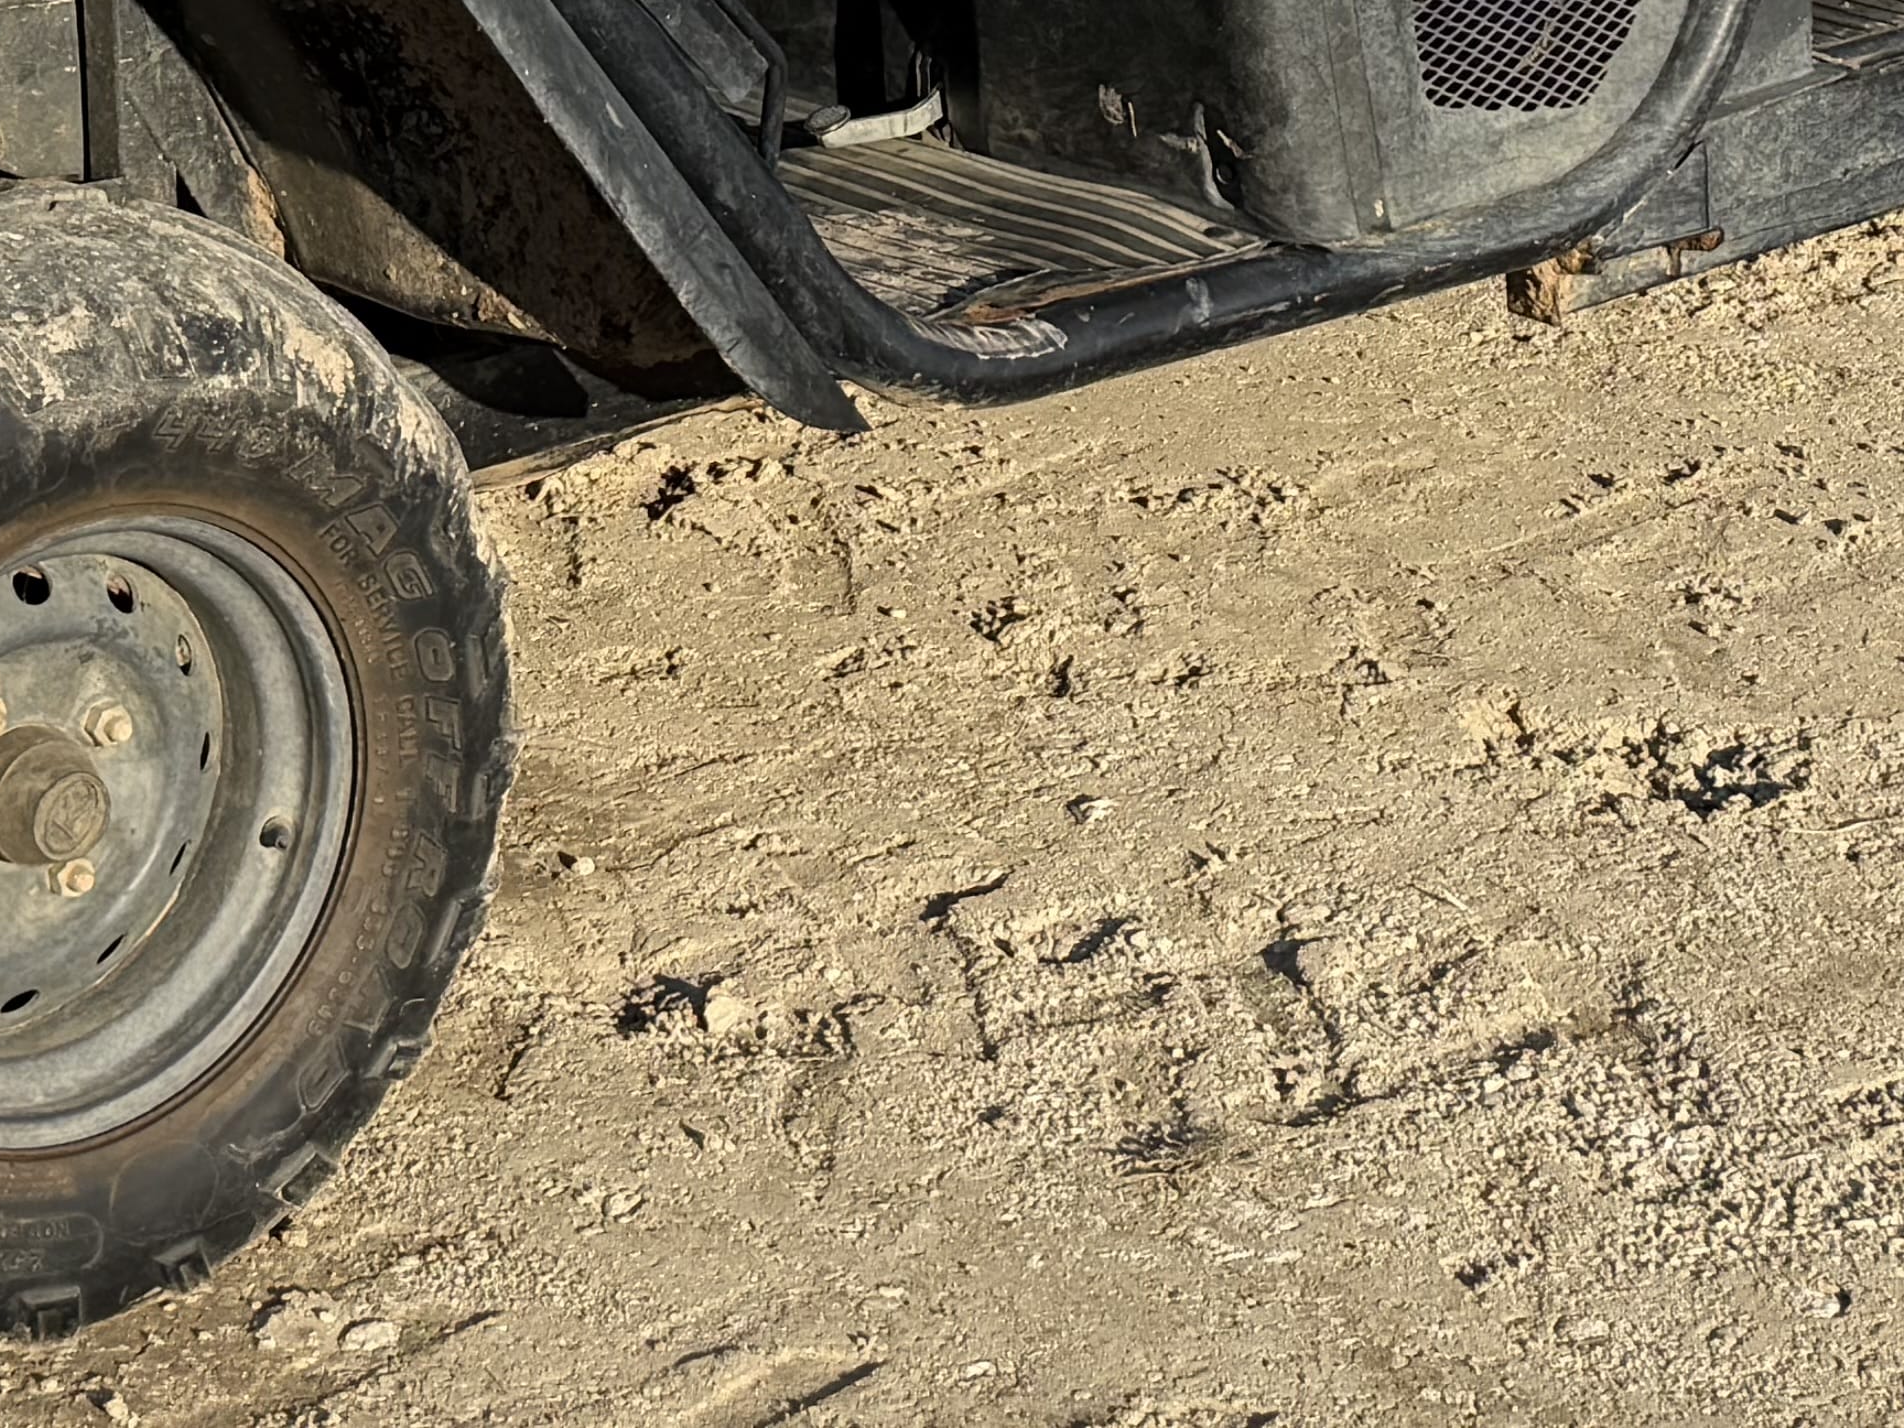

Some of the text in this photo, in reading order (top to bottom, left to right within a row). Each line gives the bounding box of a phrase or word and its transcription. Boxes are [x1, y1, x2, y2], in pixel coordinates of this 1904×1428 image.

[286, 447, 435, 602] MAG
[357, 573, 409, 681] SERVICE
[413, 627, 465, 815] OFF
[298, 829, 449, 1117] ROAD
